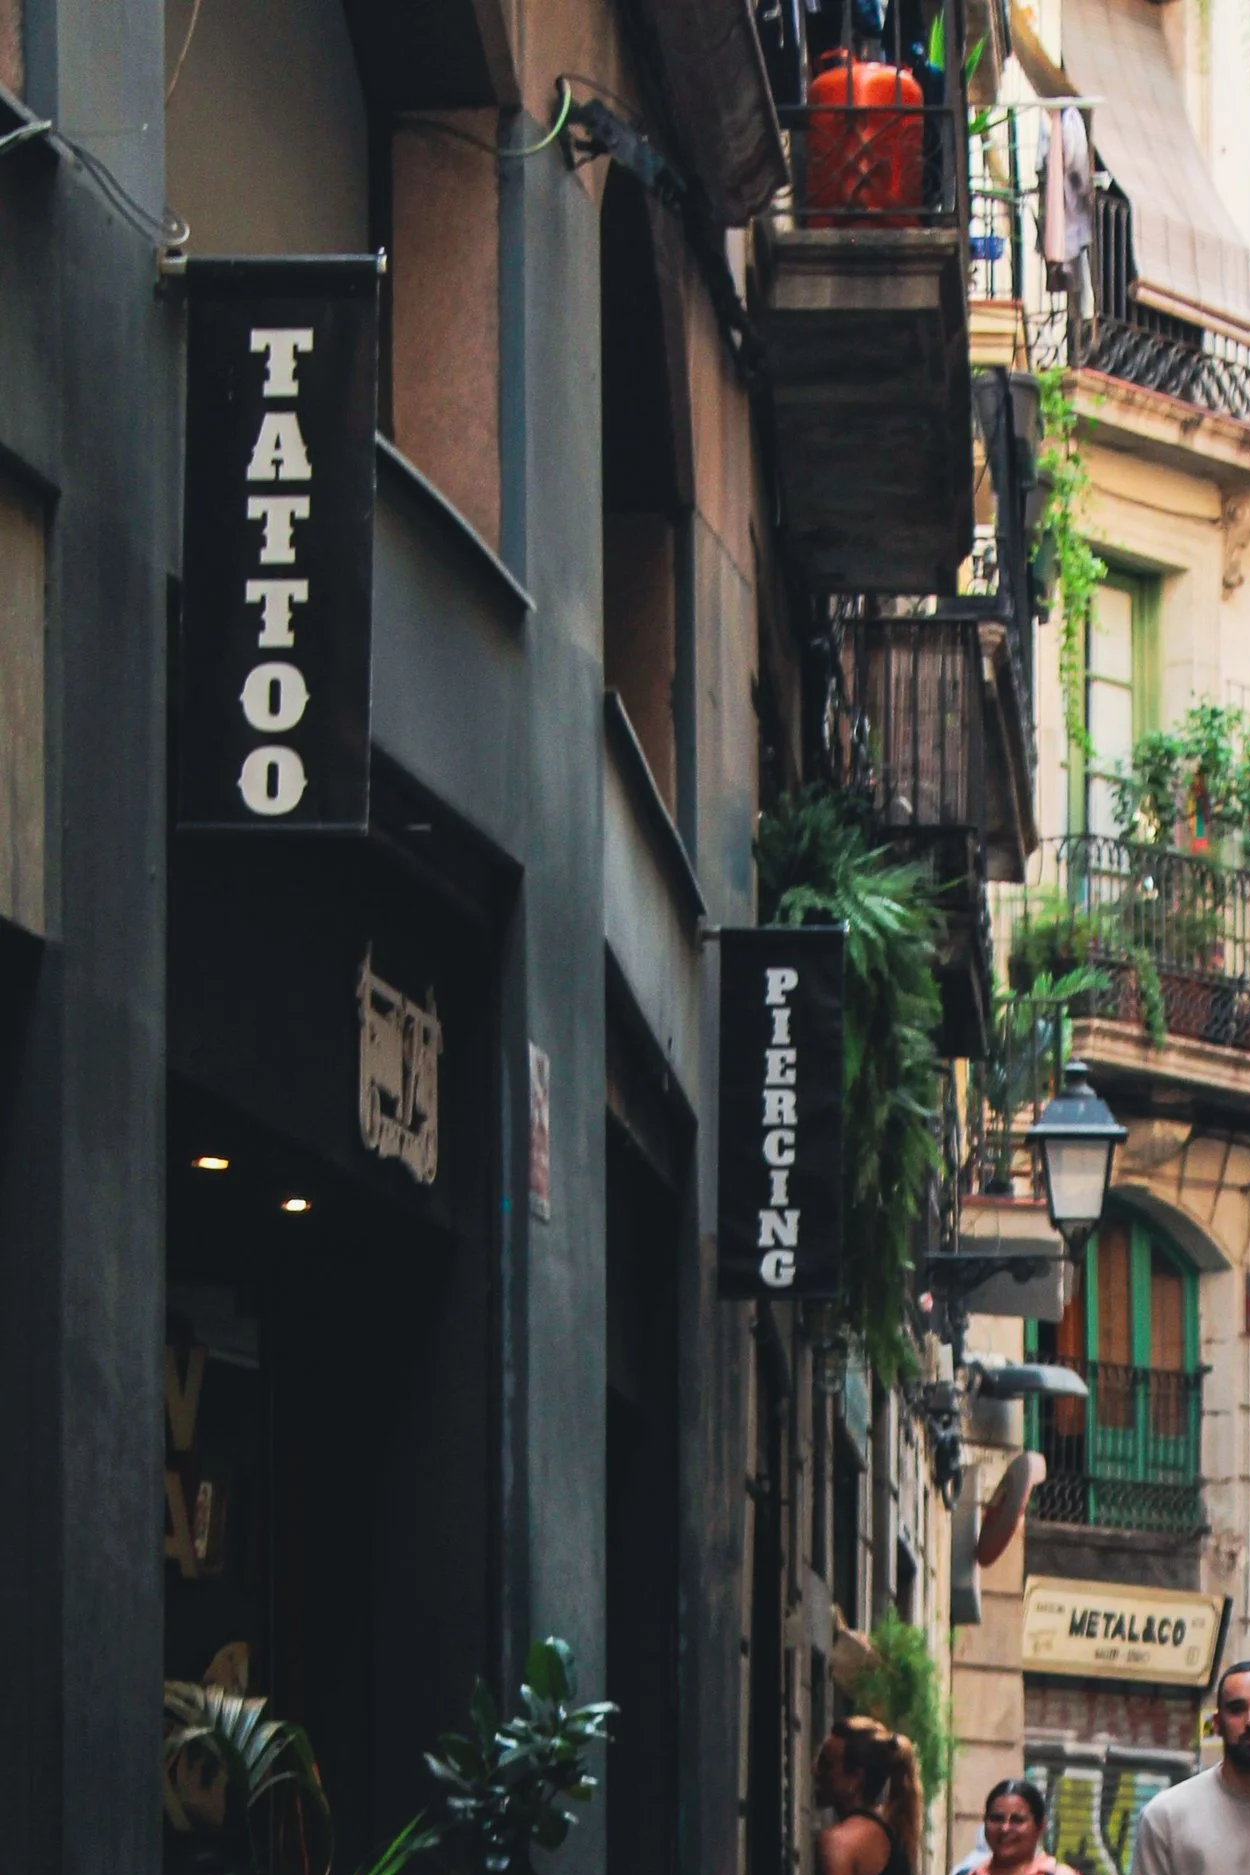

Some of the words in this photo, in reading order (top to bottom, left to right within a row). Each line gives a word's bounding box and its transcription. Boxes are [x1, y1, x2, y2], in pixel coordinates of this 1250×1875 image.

[237, 327, 314, 816] TATTOO
[758, 966, 801, 1287] PIERCING
[1068, 1606, 1187, 1648] METAL&CO
